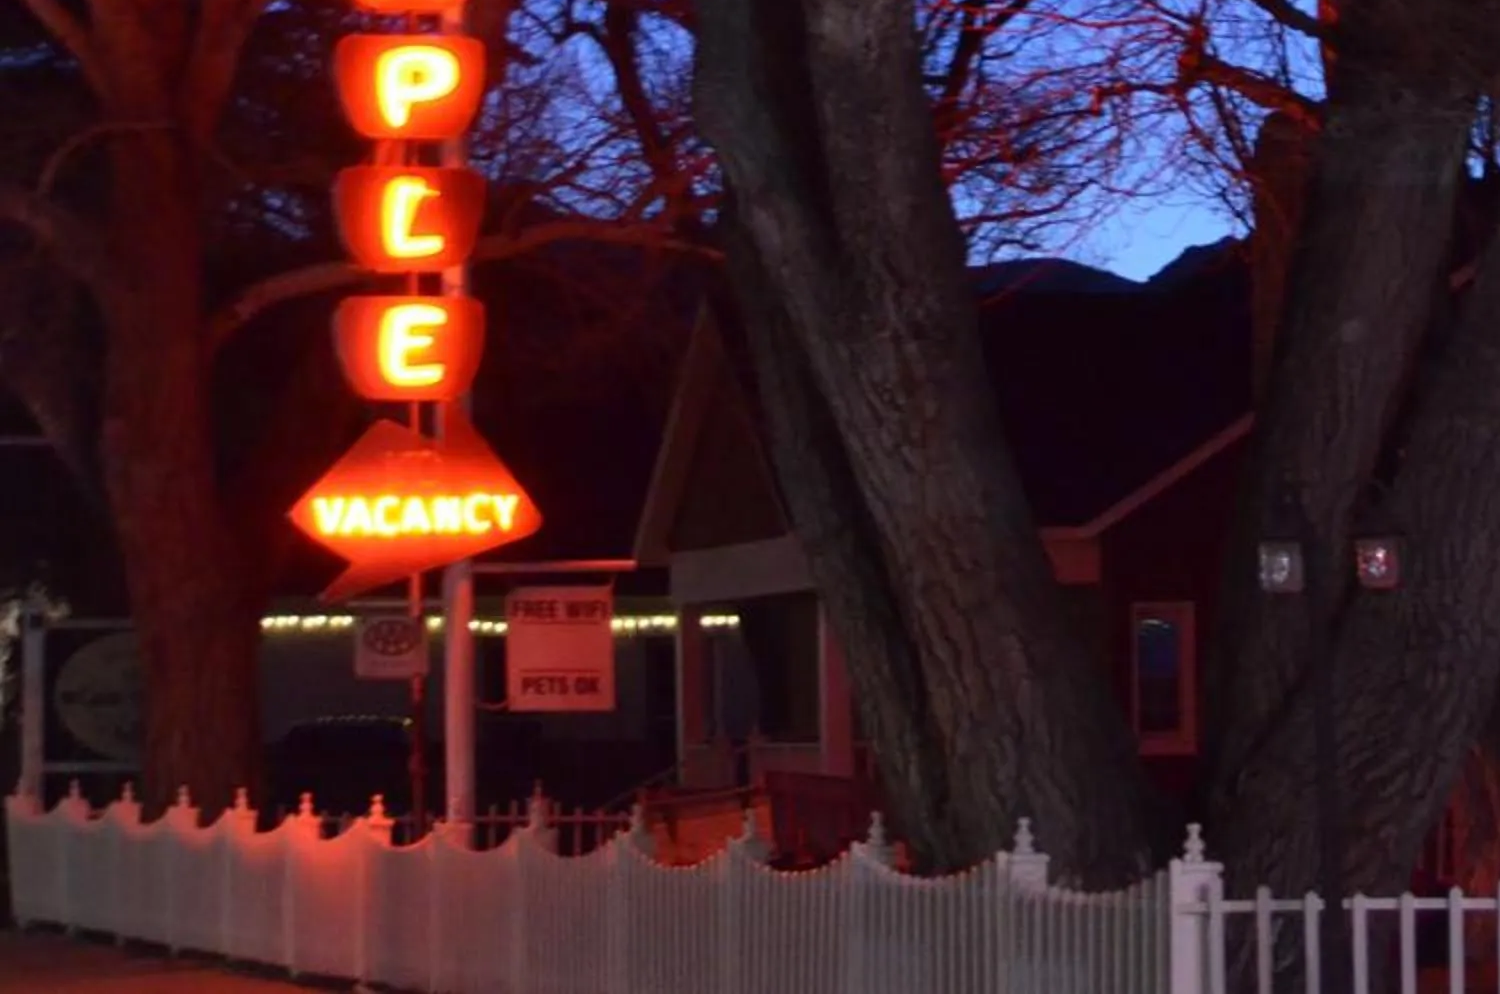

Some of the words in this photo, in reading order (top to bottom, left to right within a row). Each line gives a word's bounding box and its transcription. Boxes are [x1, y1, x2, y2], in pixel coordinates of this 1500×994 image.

[312, 490, 519, 536] VACANCY
[511, 599, 558, 620] FREE
[521, 675, 569, 696] PETS
[574, 675, 601, 696] OK
